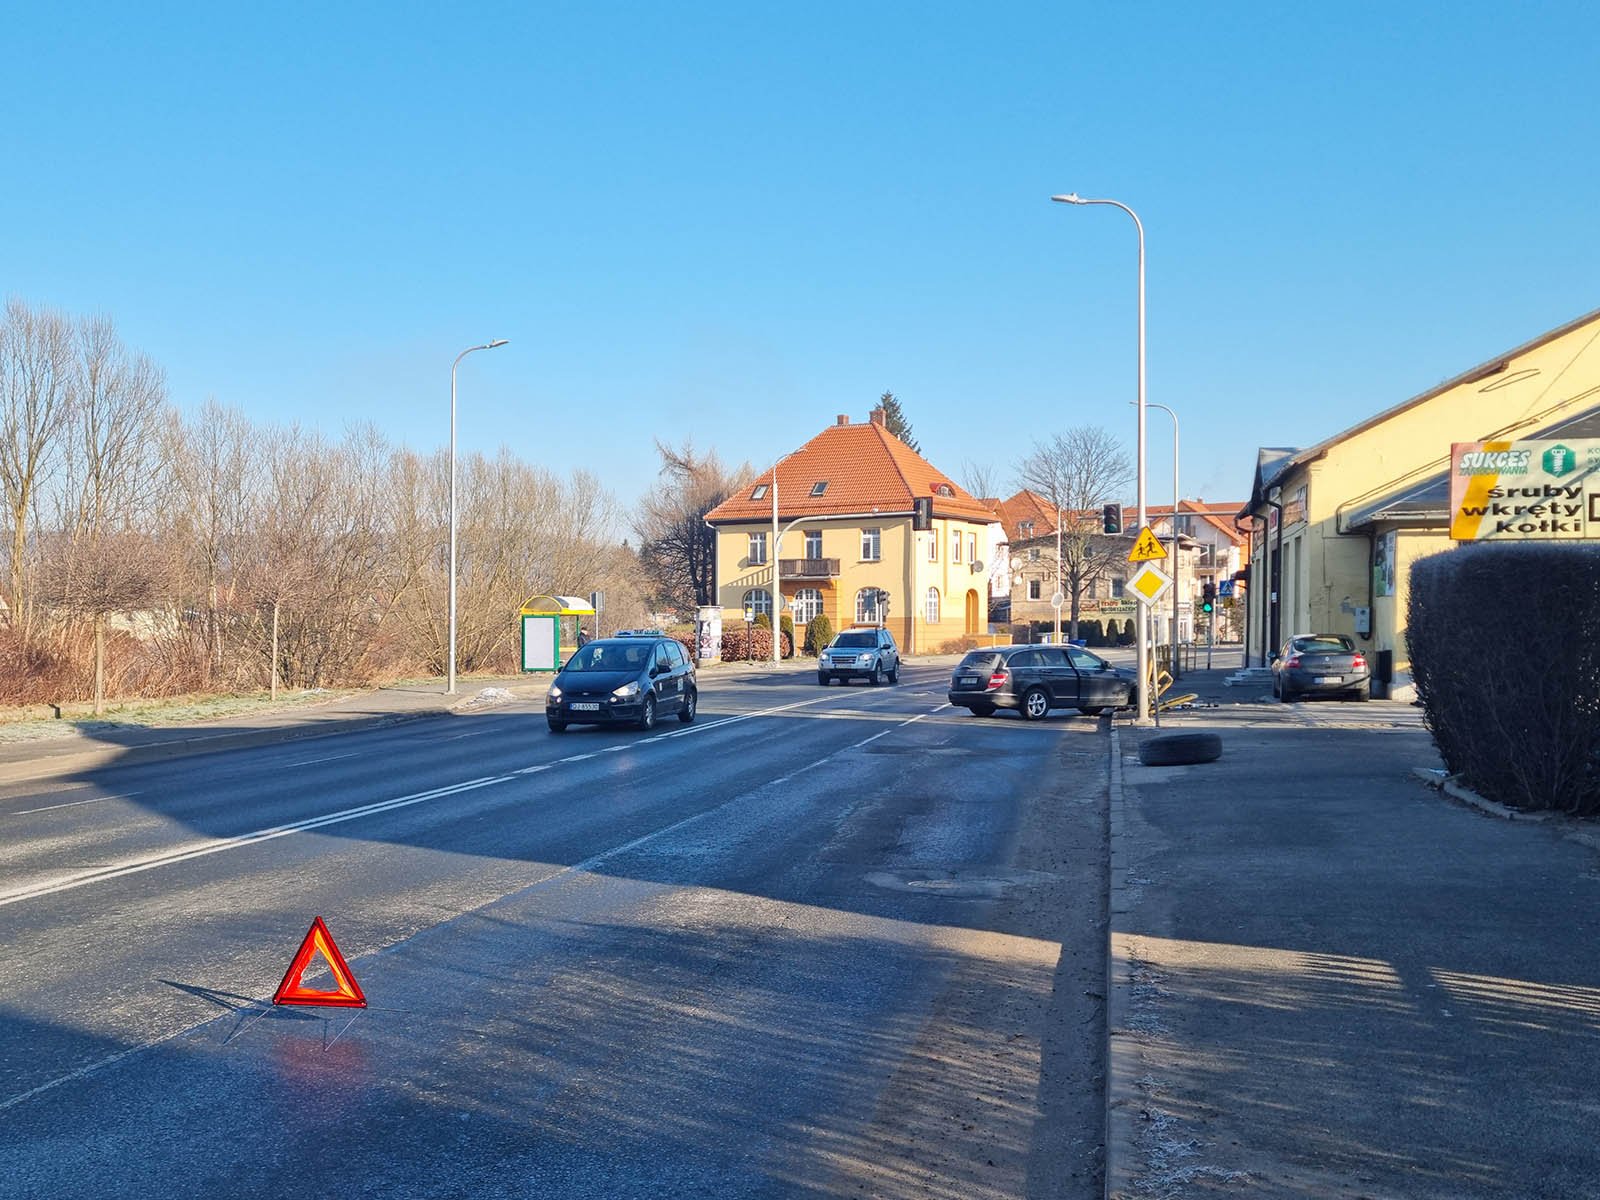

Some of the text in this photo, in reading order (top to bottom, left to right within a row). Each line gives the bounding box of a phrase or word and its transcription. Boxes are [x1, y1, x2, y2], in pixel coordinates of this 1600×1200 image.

[1460, 450, 1532, 469] SUKCES
[1462, 502, 1583, 518] wkręty
[1496, 519, 1581, 533] kołki
